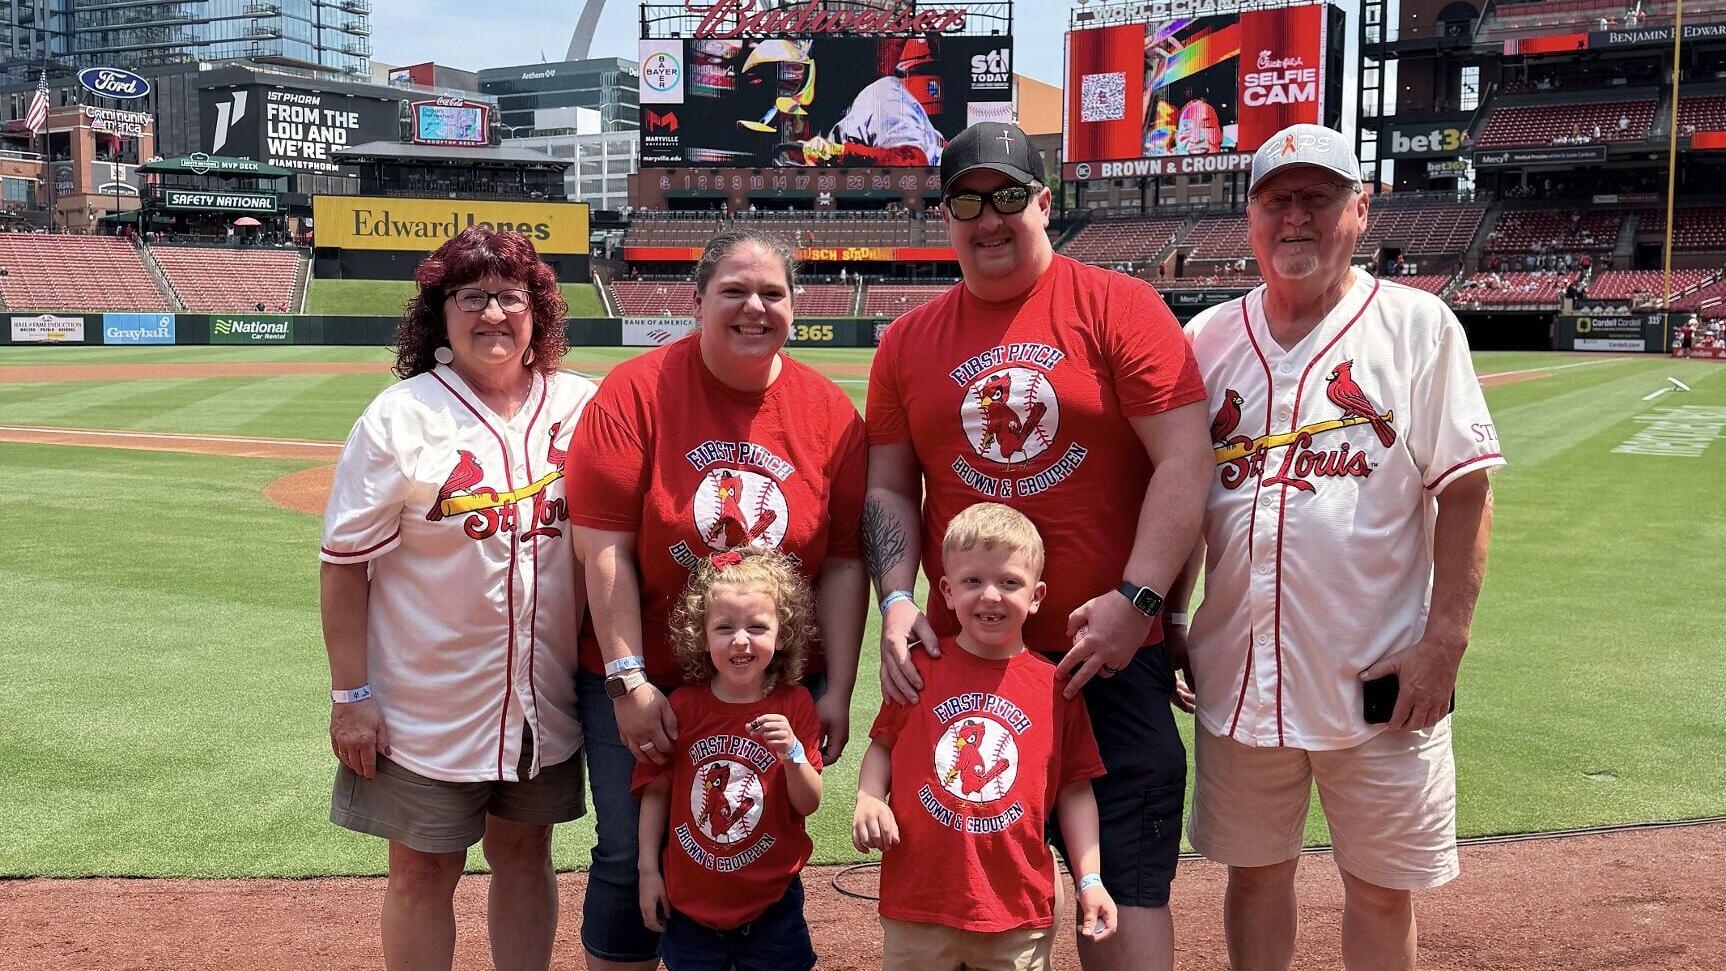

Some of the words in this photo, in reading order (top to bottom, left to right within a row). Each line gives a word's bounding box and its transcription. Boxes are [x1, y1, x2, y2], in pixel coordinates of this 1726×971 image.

[685, 0, 967, 39] Budweiser
[1094, 3, 1170, 22] WORLD
[1610, 29, 1668, 44] BENJAMIN
[95, 70, 137, 94] Ford
[646, 68, 678, 76] BAYER
[971, 73, 1009, 82] TODAY
[1243, 68, 1316, 87] SELFIE
[267, 91, 283, 102] 1ST
[1243, 82, 1316, 107] CAM
[86, 105, 151, 127] Community
[266, 103, 320, 125] FROM
[323, 109, 360, 129] THE
[266, 120, 304, 140] LOU
[308, 125, 348, 144] AND
[266, 138, 327, 160] WE'RE
[643, 155, 682, 163] maryville.edu
[1482, 155, 1504, 164] Mercy
[221, 161, 238, 169] MVP
[1101, 160, 1162, 178] BROWN
[1166, 162, 1177, 174] &
[1181, 153, 1254, 173] CROUPP
[172, 193, 215, 206] SAFETY
[217, 194, 272, 209] NATIONAL
[351, 209, 459, 239] Edward
[1592, 318, 1617, 327] Cordell
[949, 345, 1005, 388] FIRST
[1006, 342, 1066, 371] PITCH
[685, 440, 736, 472] FIRST
[737, 441, 796, 482] PITCH
[951, 455, 999, 497] BROWN
[1000, 479, 1012, 498] &
[1016, 441, 1088, 496] CROUPPEN
[1220, 434, 1264, 490] St.
[1262, 431, 1374, 495] Louis
[463, 486, 518, 540] St.
[933, 692, 984, 724] FIRST
[984, 692, 1033, 736] PITCH
[687, 734, 729, 766] FIRST
[728, 735, 777, 773] PITCH
[917, 784, 954, 827] BROWN
[954, 813, 963, 832] &
[674, 822, 708, 865] BROWN
[705, 855, 715, 871] &
[716, 833, 776, 873] CROUPPEN
